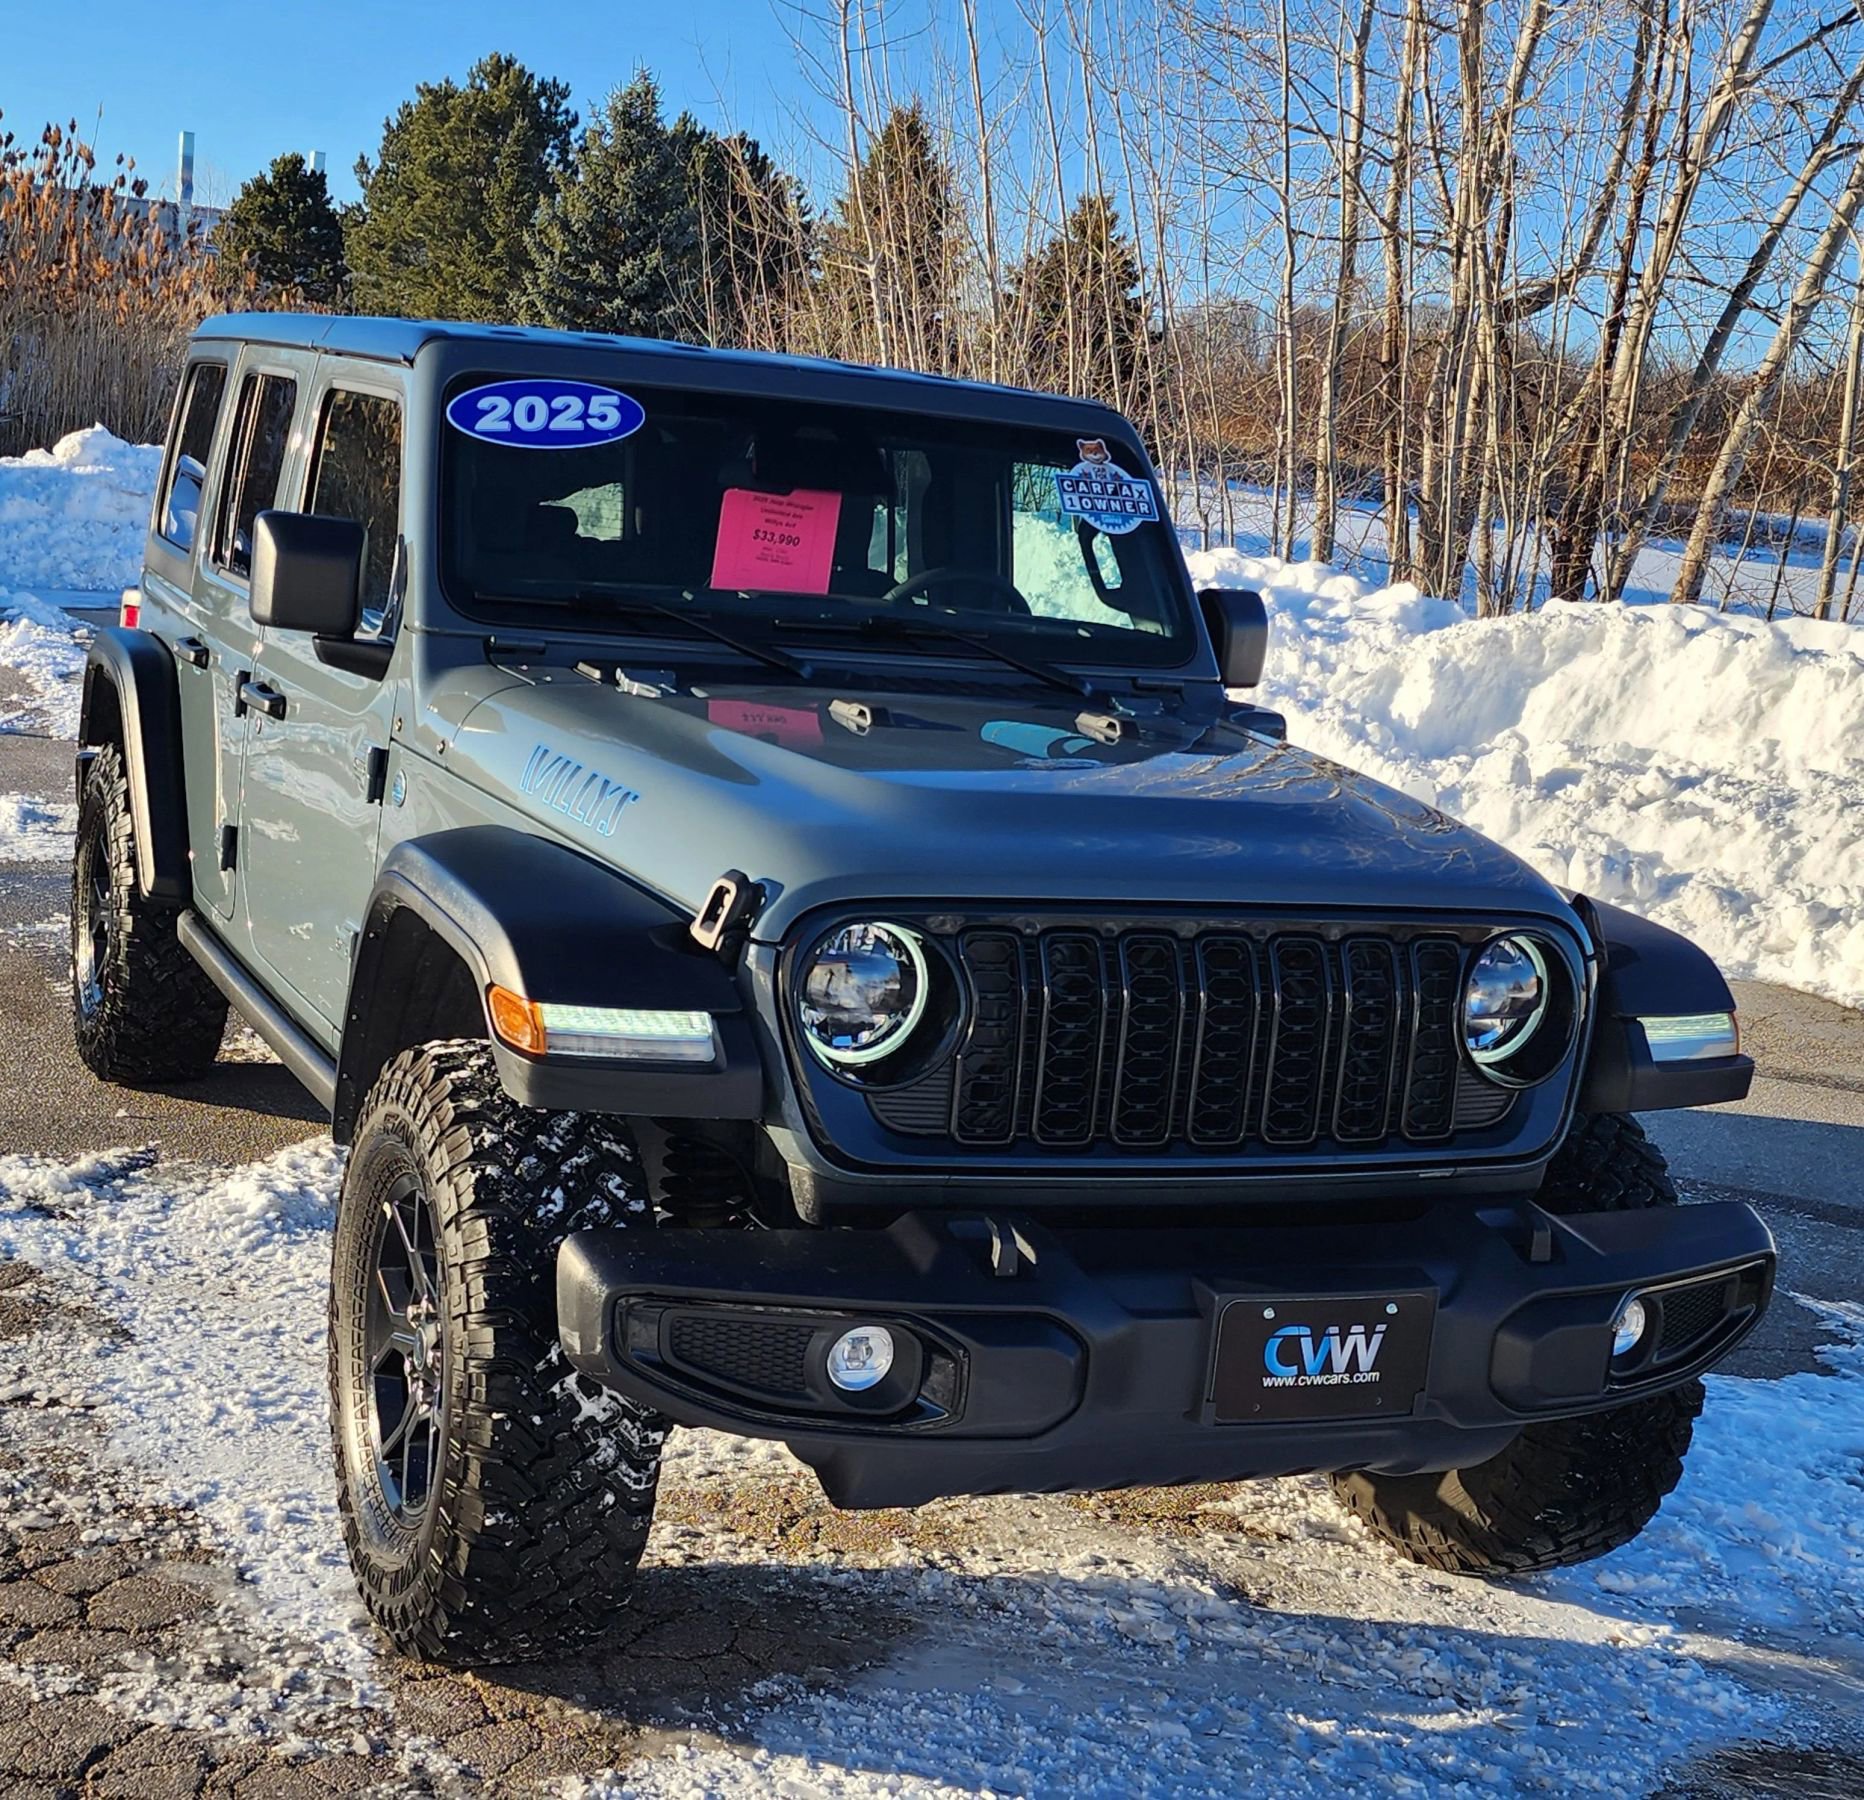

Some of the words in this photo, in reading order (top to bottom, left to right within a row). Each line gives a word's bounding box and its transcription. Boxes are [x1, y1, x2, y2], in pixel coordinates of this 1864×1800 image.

[474, 395, 621, 432] 2025
[1063, 479, 1145, 500] CARFAX
[1067, 497, 1078, 508] 1
[1081, 498, 1150, 514] OWNER
[753, 529, 801, 547] $33,990
[520, 745, 639, 837] WILLYS
[1264, 1323, 1388, 1377] CVW
[1262, 1371, 1380, 1388] www.cvwcars.com
